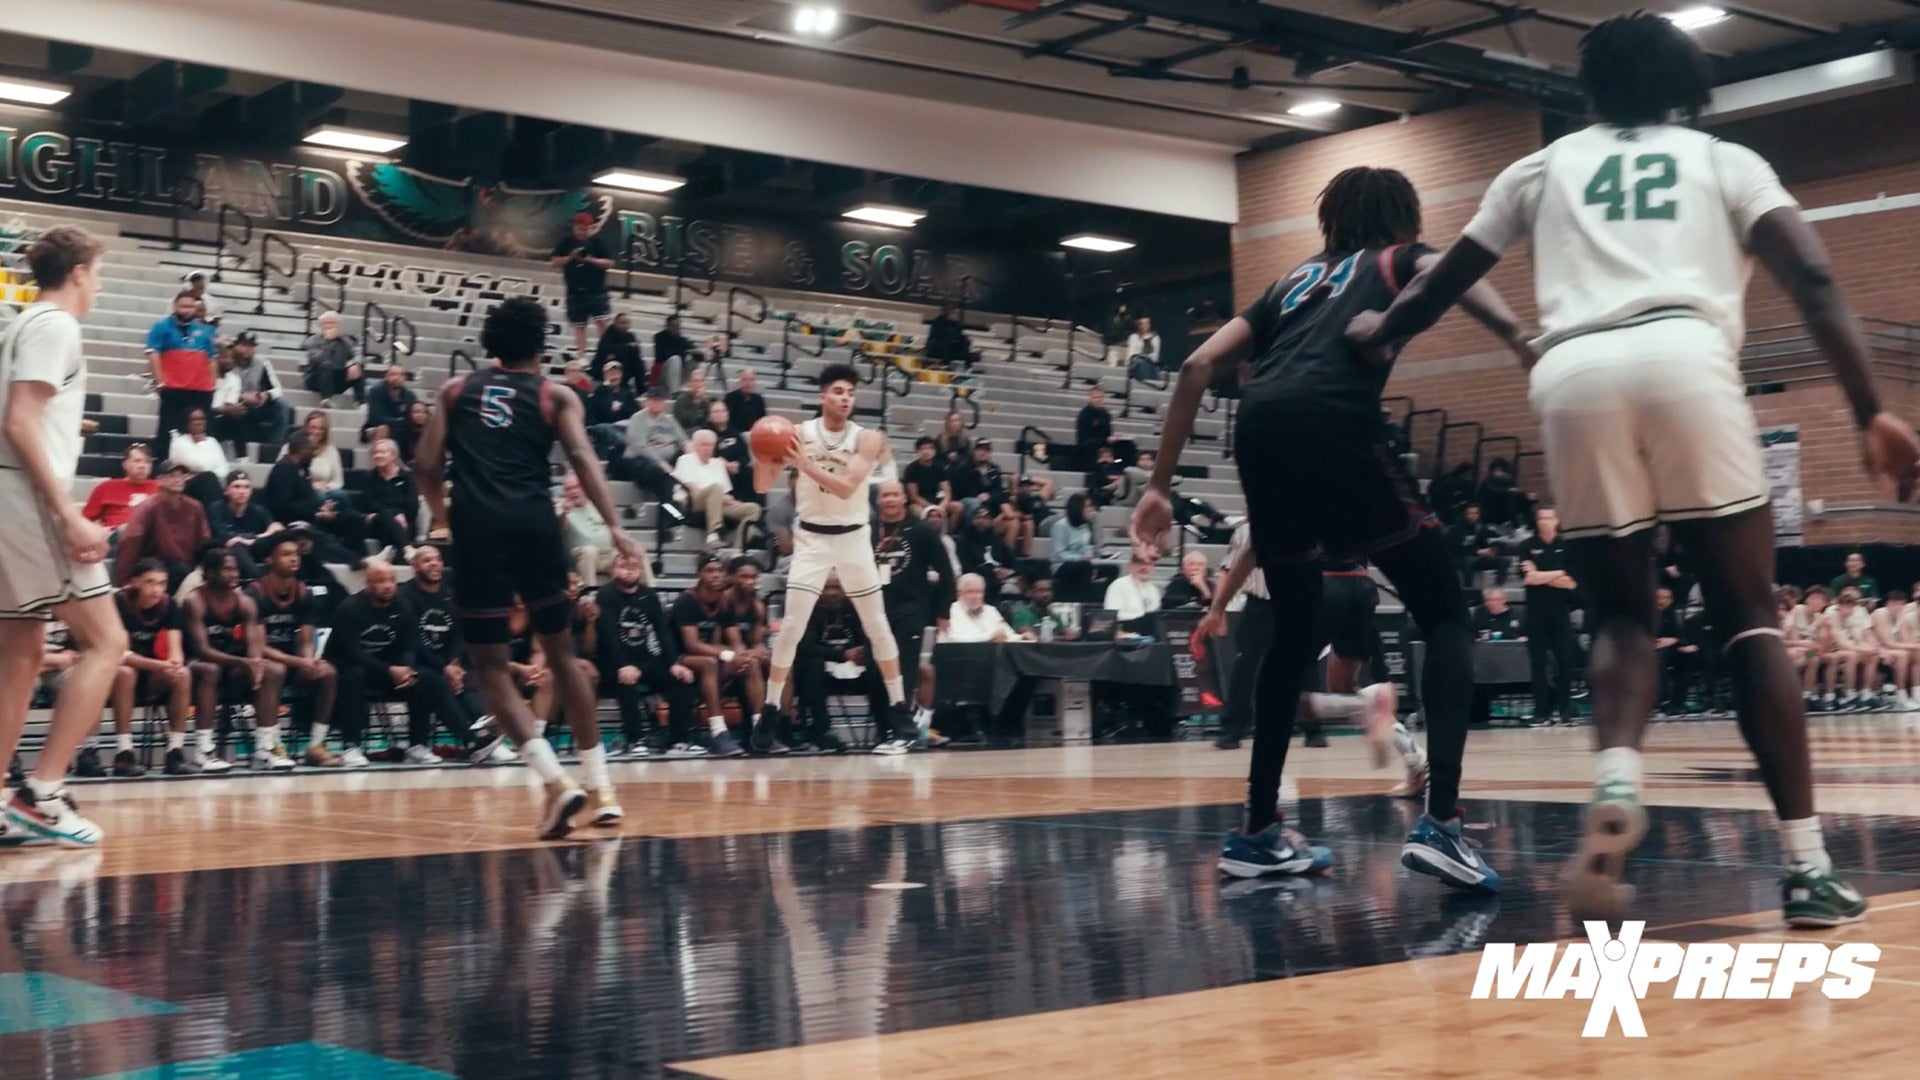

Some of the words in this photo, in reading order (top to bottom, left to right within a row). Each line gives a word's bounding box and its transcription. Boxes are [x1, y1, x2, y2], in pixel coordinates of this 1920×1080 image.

[1583, 152, 1678, 221] 42
[617, 209, 753, 277] RISE
[480, 384, 517, 429] 5
